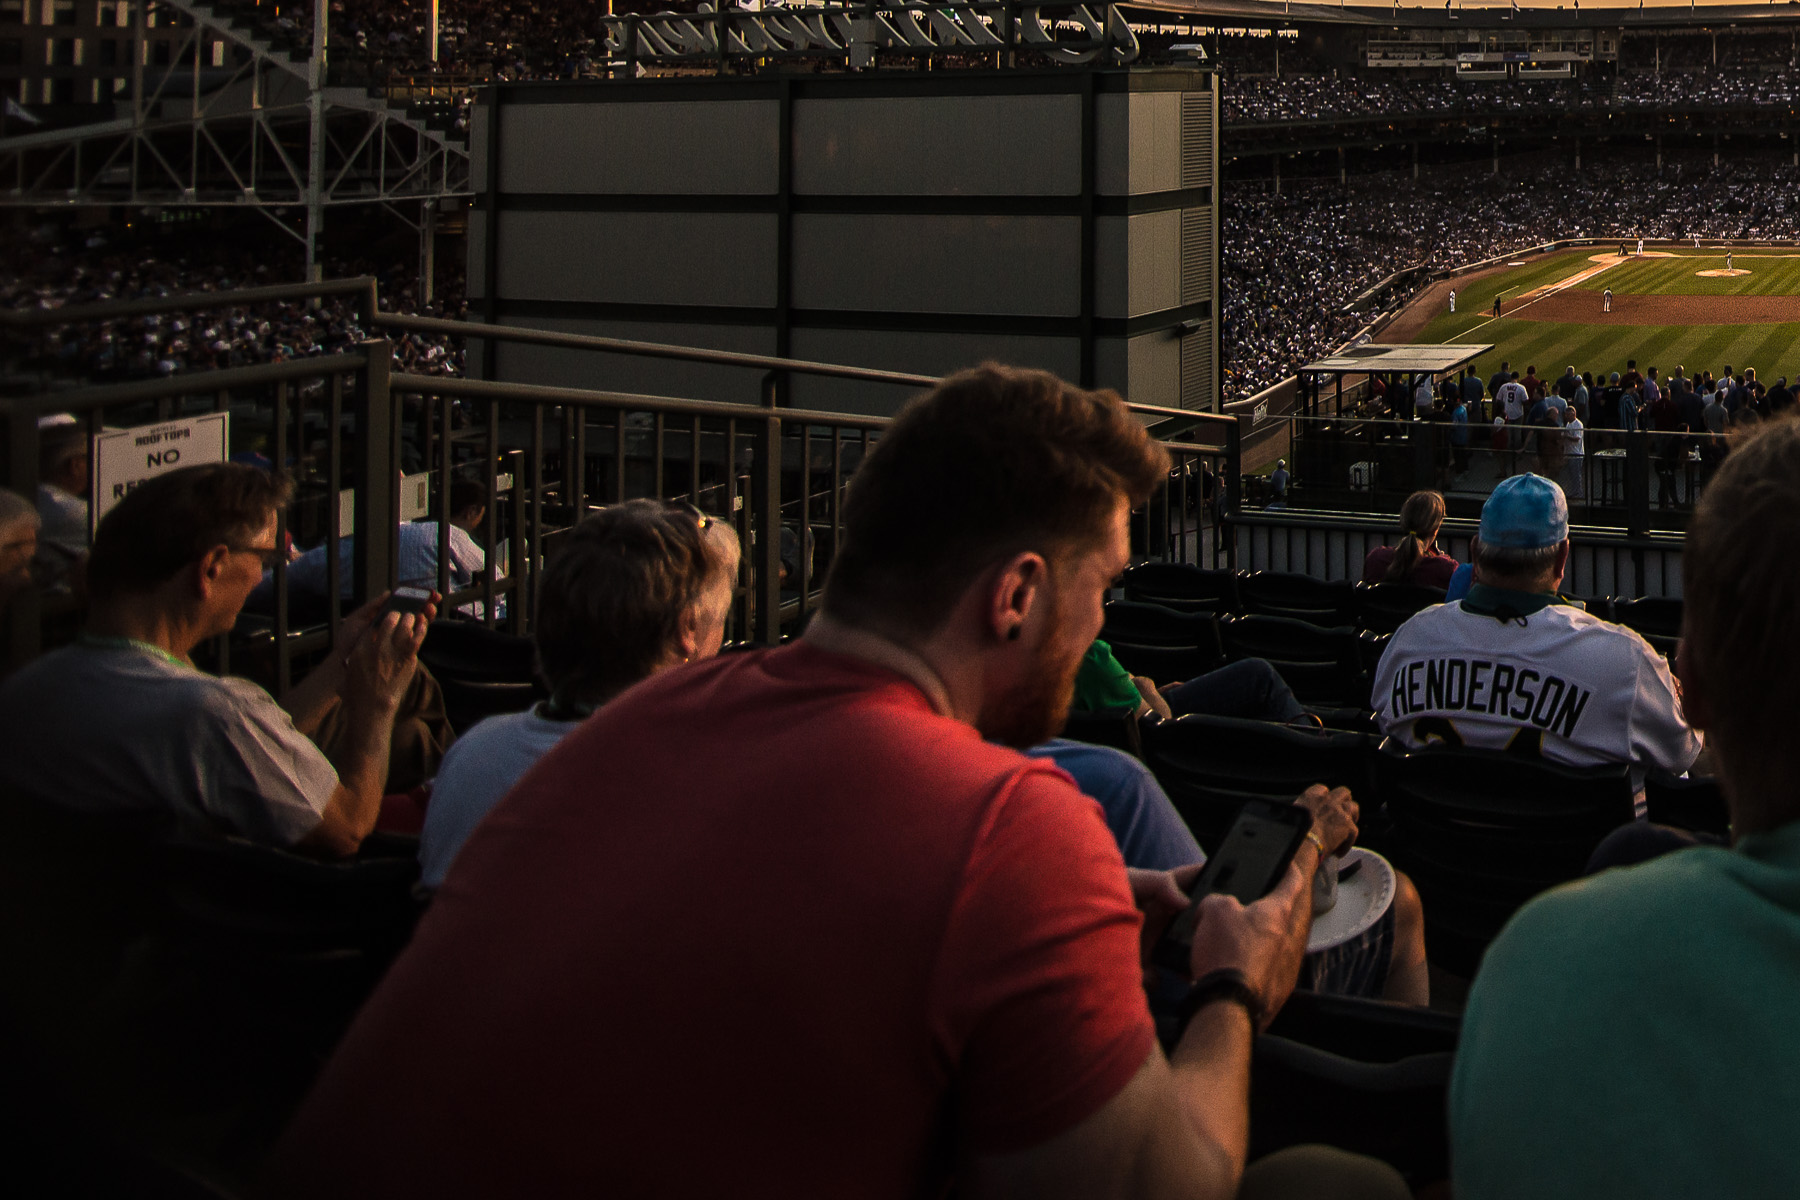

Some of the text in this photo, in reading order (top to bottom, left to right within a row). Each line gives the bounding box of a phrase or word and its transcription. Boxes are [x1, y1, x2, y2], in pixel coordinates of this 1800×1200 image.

[135, 428, 190, 447] ROOFTOPS
[147, 449, 180, 468] NO
[1391, 658, 1591, 739] HENDERSON
